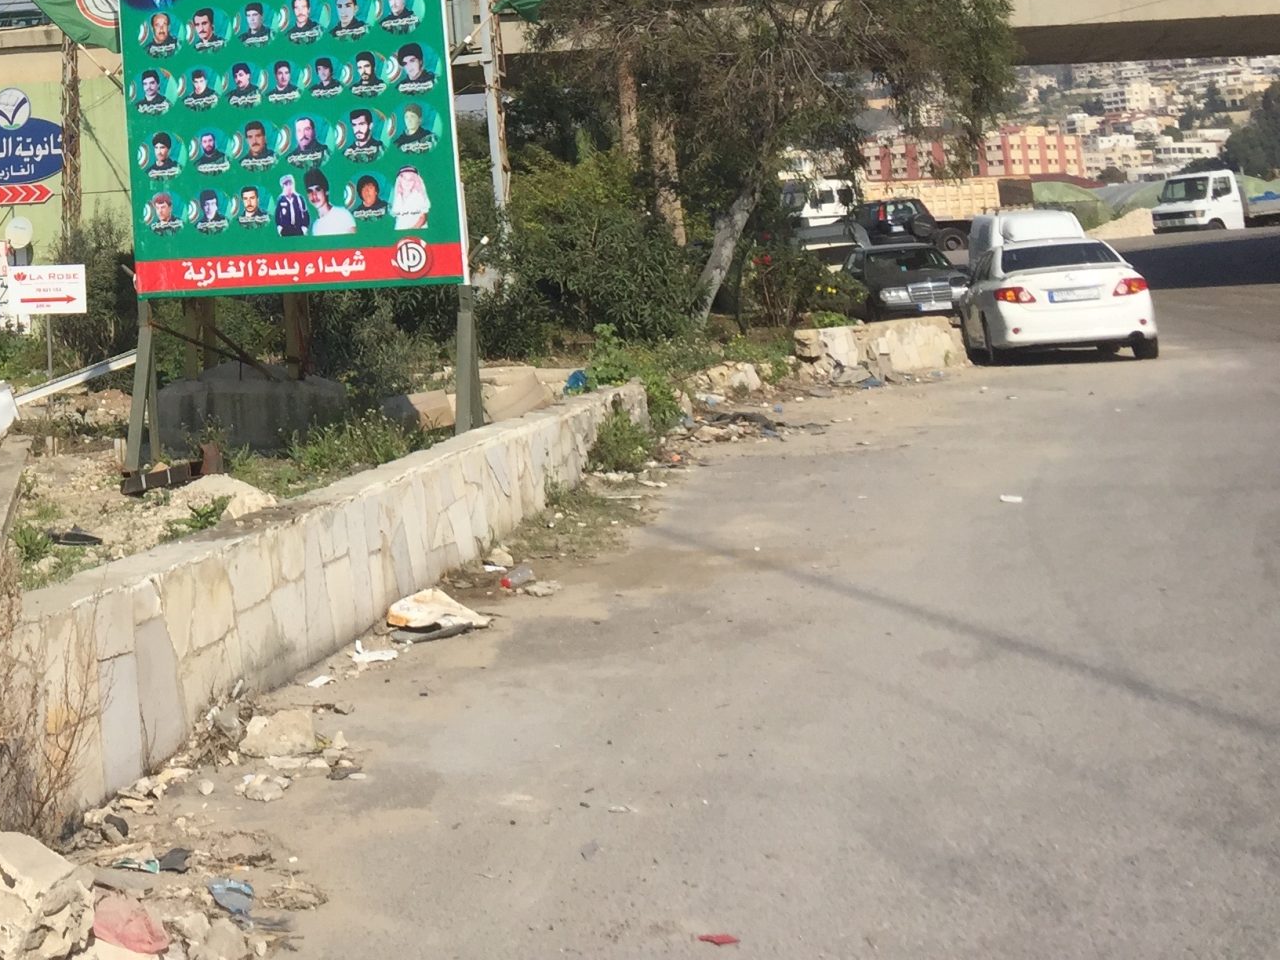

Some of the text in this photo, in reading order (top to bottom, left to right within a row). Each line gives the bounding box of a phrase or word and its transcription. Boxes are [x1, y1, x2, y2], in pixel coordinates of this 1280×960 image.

[29, 272, 80, 281] LA ROSE
[181, 250, 366, 288] شهداء بلدة الغازية
